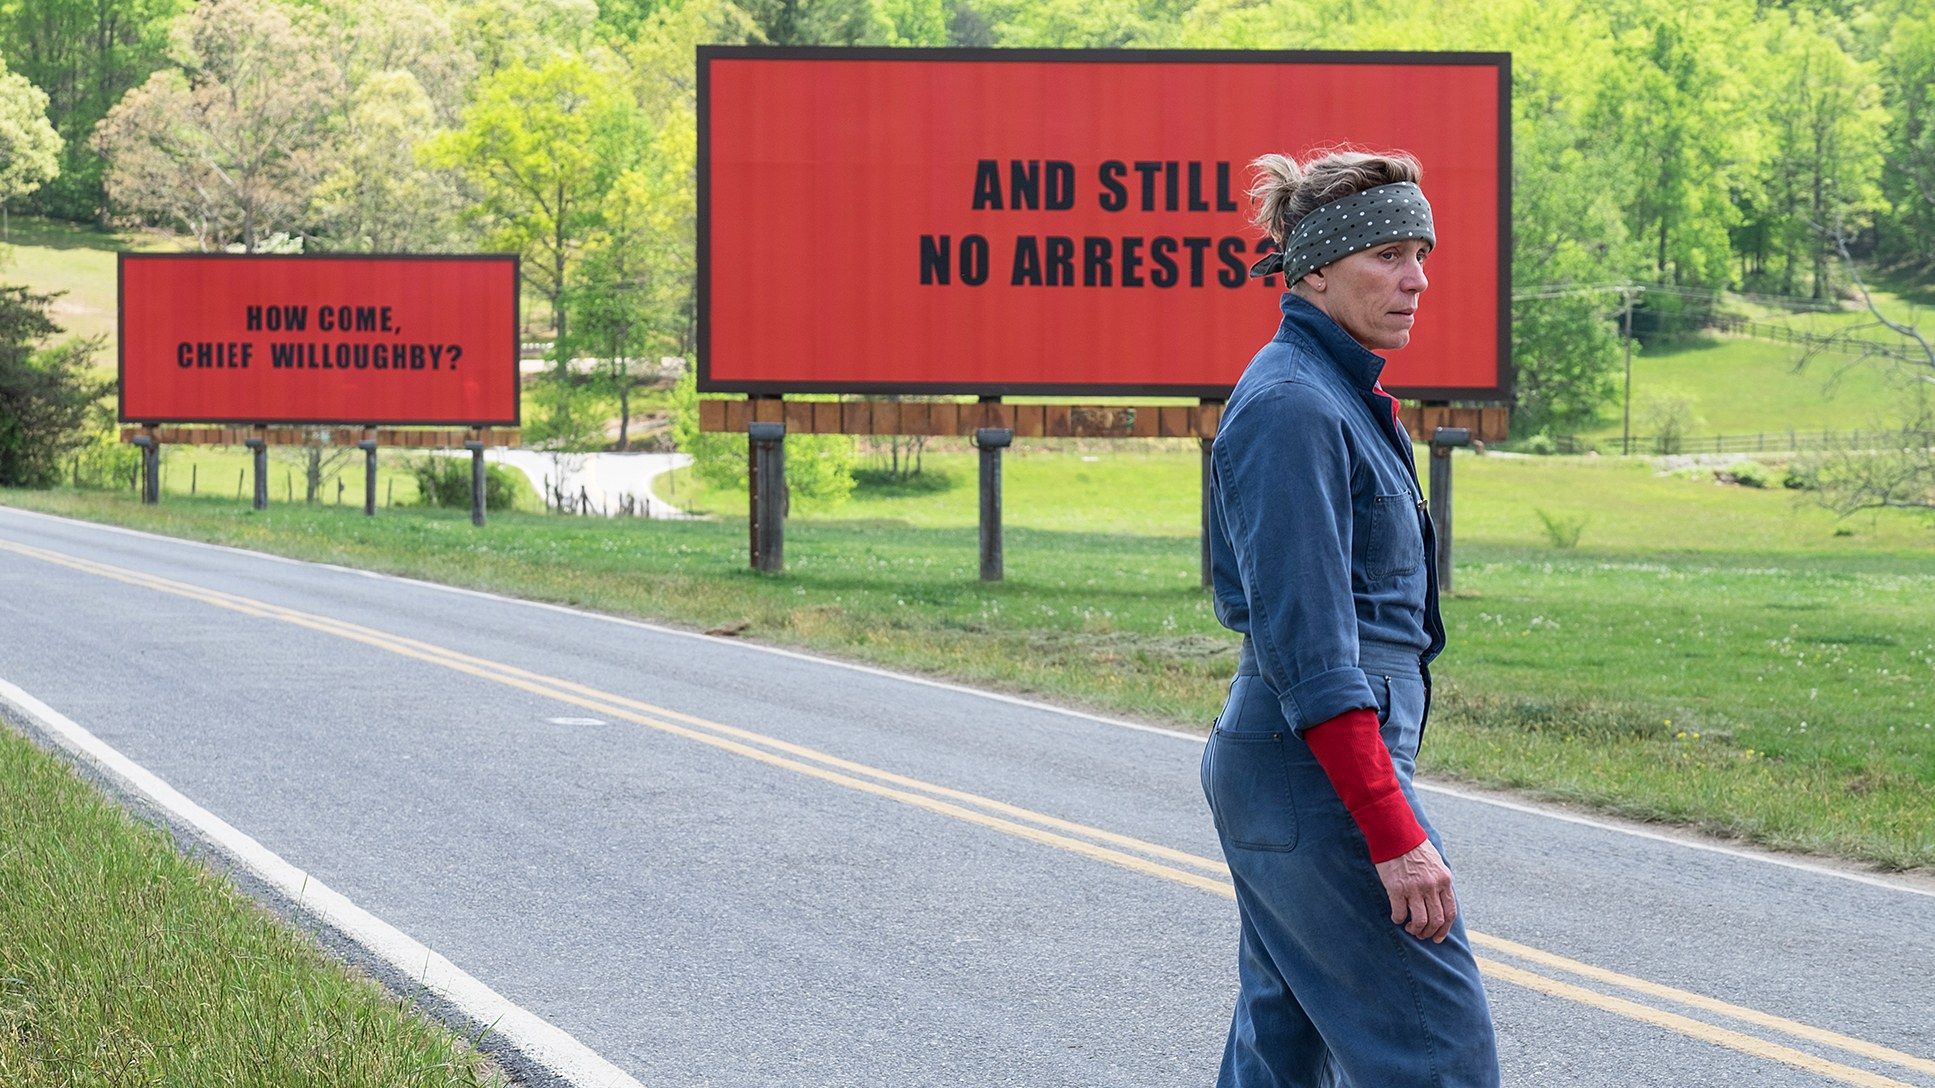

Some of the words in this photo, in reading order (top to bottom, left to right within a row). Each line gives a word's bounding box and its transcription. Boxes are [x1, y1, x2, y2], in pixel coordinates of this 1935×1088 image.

[973, 159, 1075, 211] AND
[1098, 160, 1237, 213] STILL
[919, 234, 989, 287] NO
[246, 305, 308, 332] HOW
[318, 305, 401, 335] COME,
[177, 342, 253, 369] CHIEF
[271, 343, 463, 370] WILLOUGHBY?
